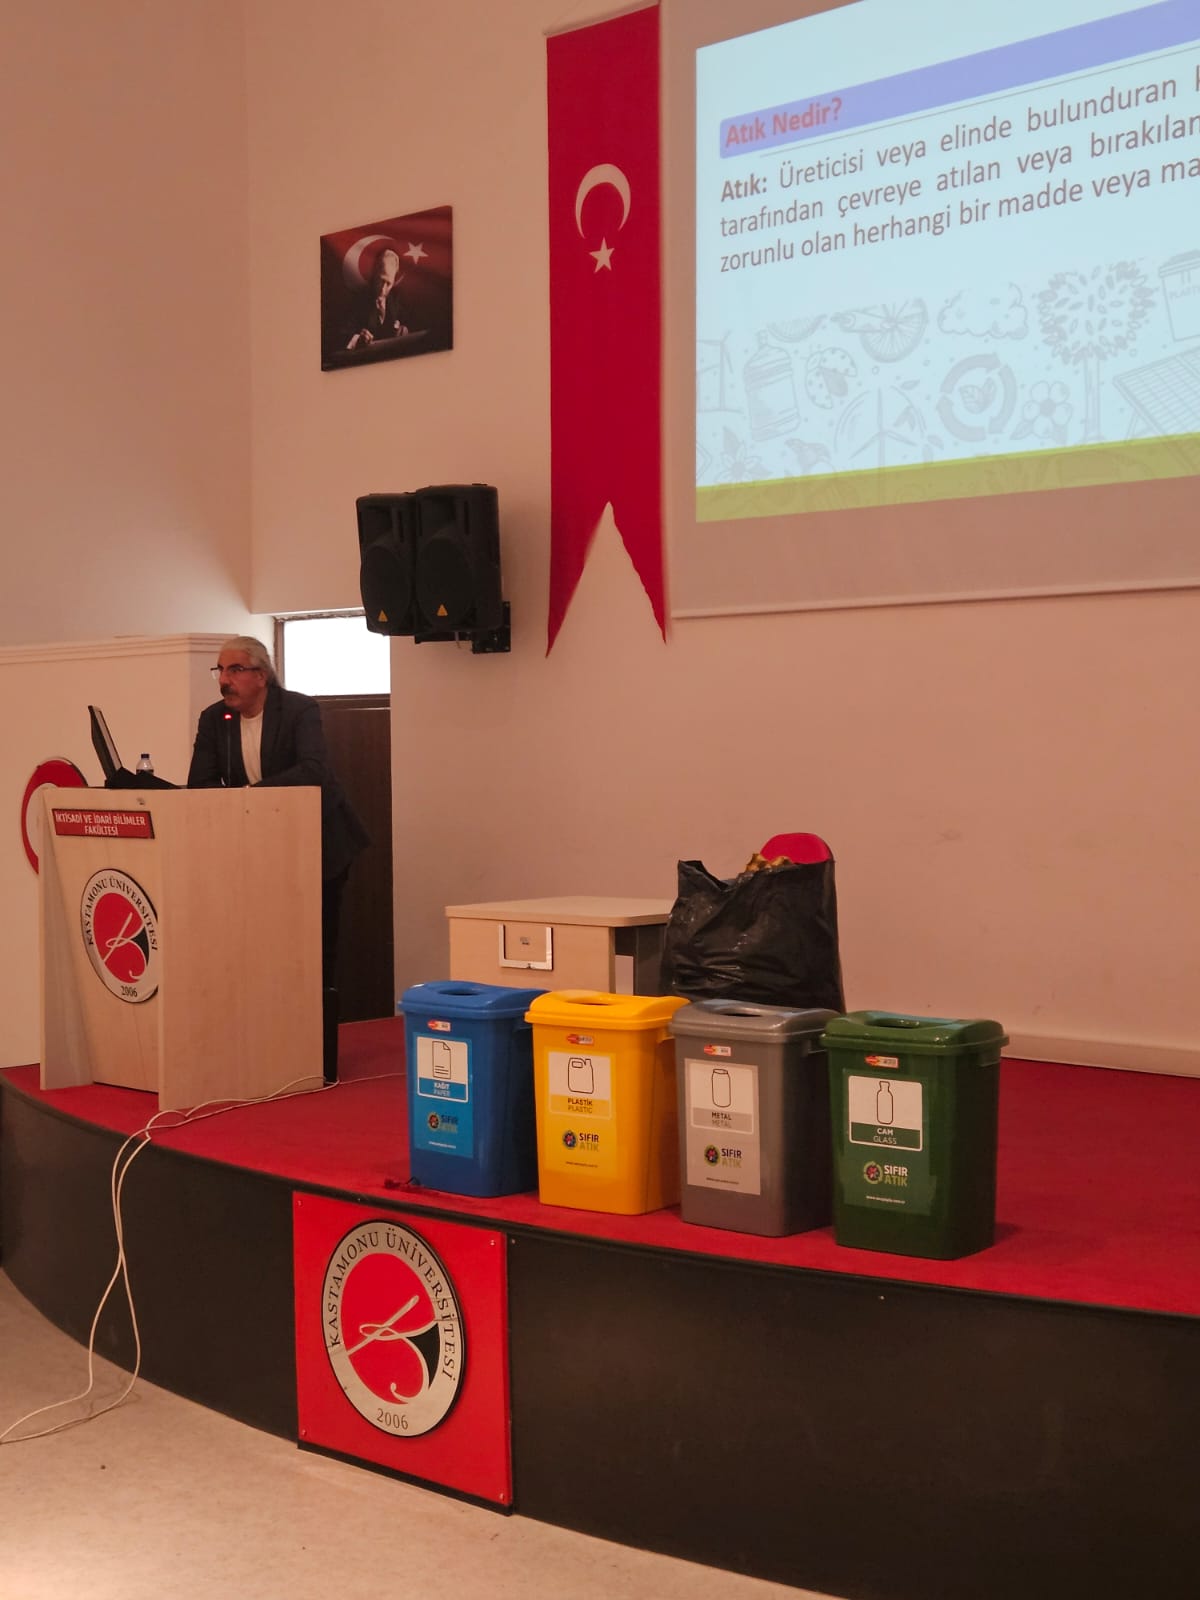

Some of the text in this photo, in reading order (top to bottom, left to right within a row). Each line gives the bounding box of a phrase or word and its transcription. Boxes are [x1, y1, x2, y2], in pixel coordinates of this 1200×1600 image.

[725, 97, 842, 148] Atık Nedir?
[721, 79, 1176, 202] Atık: Üreticisi veya elinde bulunduran
[720, 114, 1200, 237] tarafından çevreye atılan veya bırakılan
[720, 238, 794, 272] zorunlu
[801, 231, 845, 256] olan
[854, 205, 950, 246] herhangi
[960, 198, 990, 225] bir
[999, 178, 1083, 218] madde
[1092, 168, 1150, 197] veya
[83, 814, 92, 823] VE
[85, 878, 108, 945] KASTAMONU
[121, 985, 138, 998] 2006
[711, 1111, 732, 1121] METAL
[711, 1120, 732, 1128] METAL
[579, 1132, 599, 1143] SIFIR
[876, 1127, 894, 1136] CAM
[873, 1135, 897, 1145] GLASS
[721, 1148, 742, 1159] SIFIR
[884, 1164, 908, 1177] SIFIR
[884, 1174, 908, 1187] ATIK
[327, 1227, 456, 1381] KASTAMONU ÜNİVERSİTESİ
[376, 1408, 409, 1430] 2006
